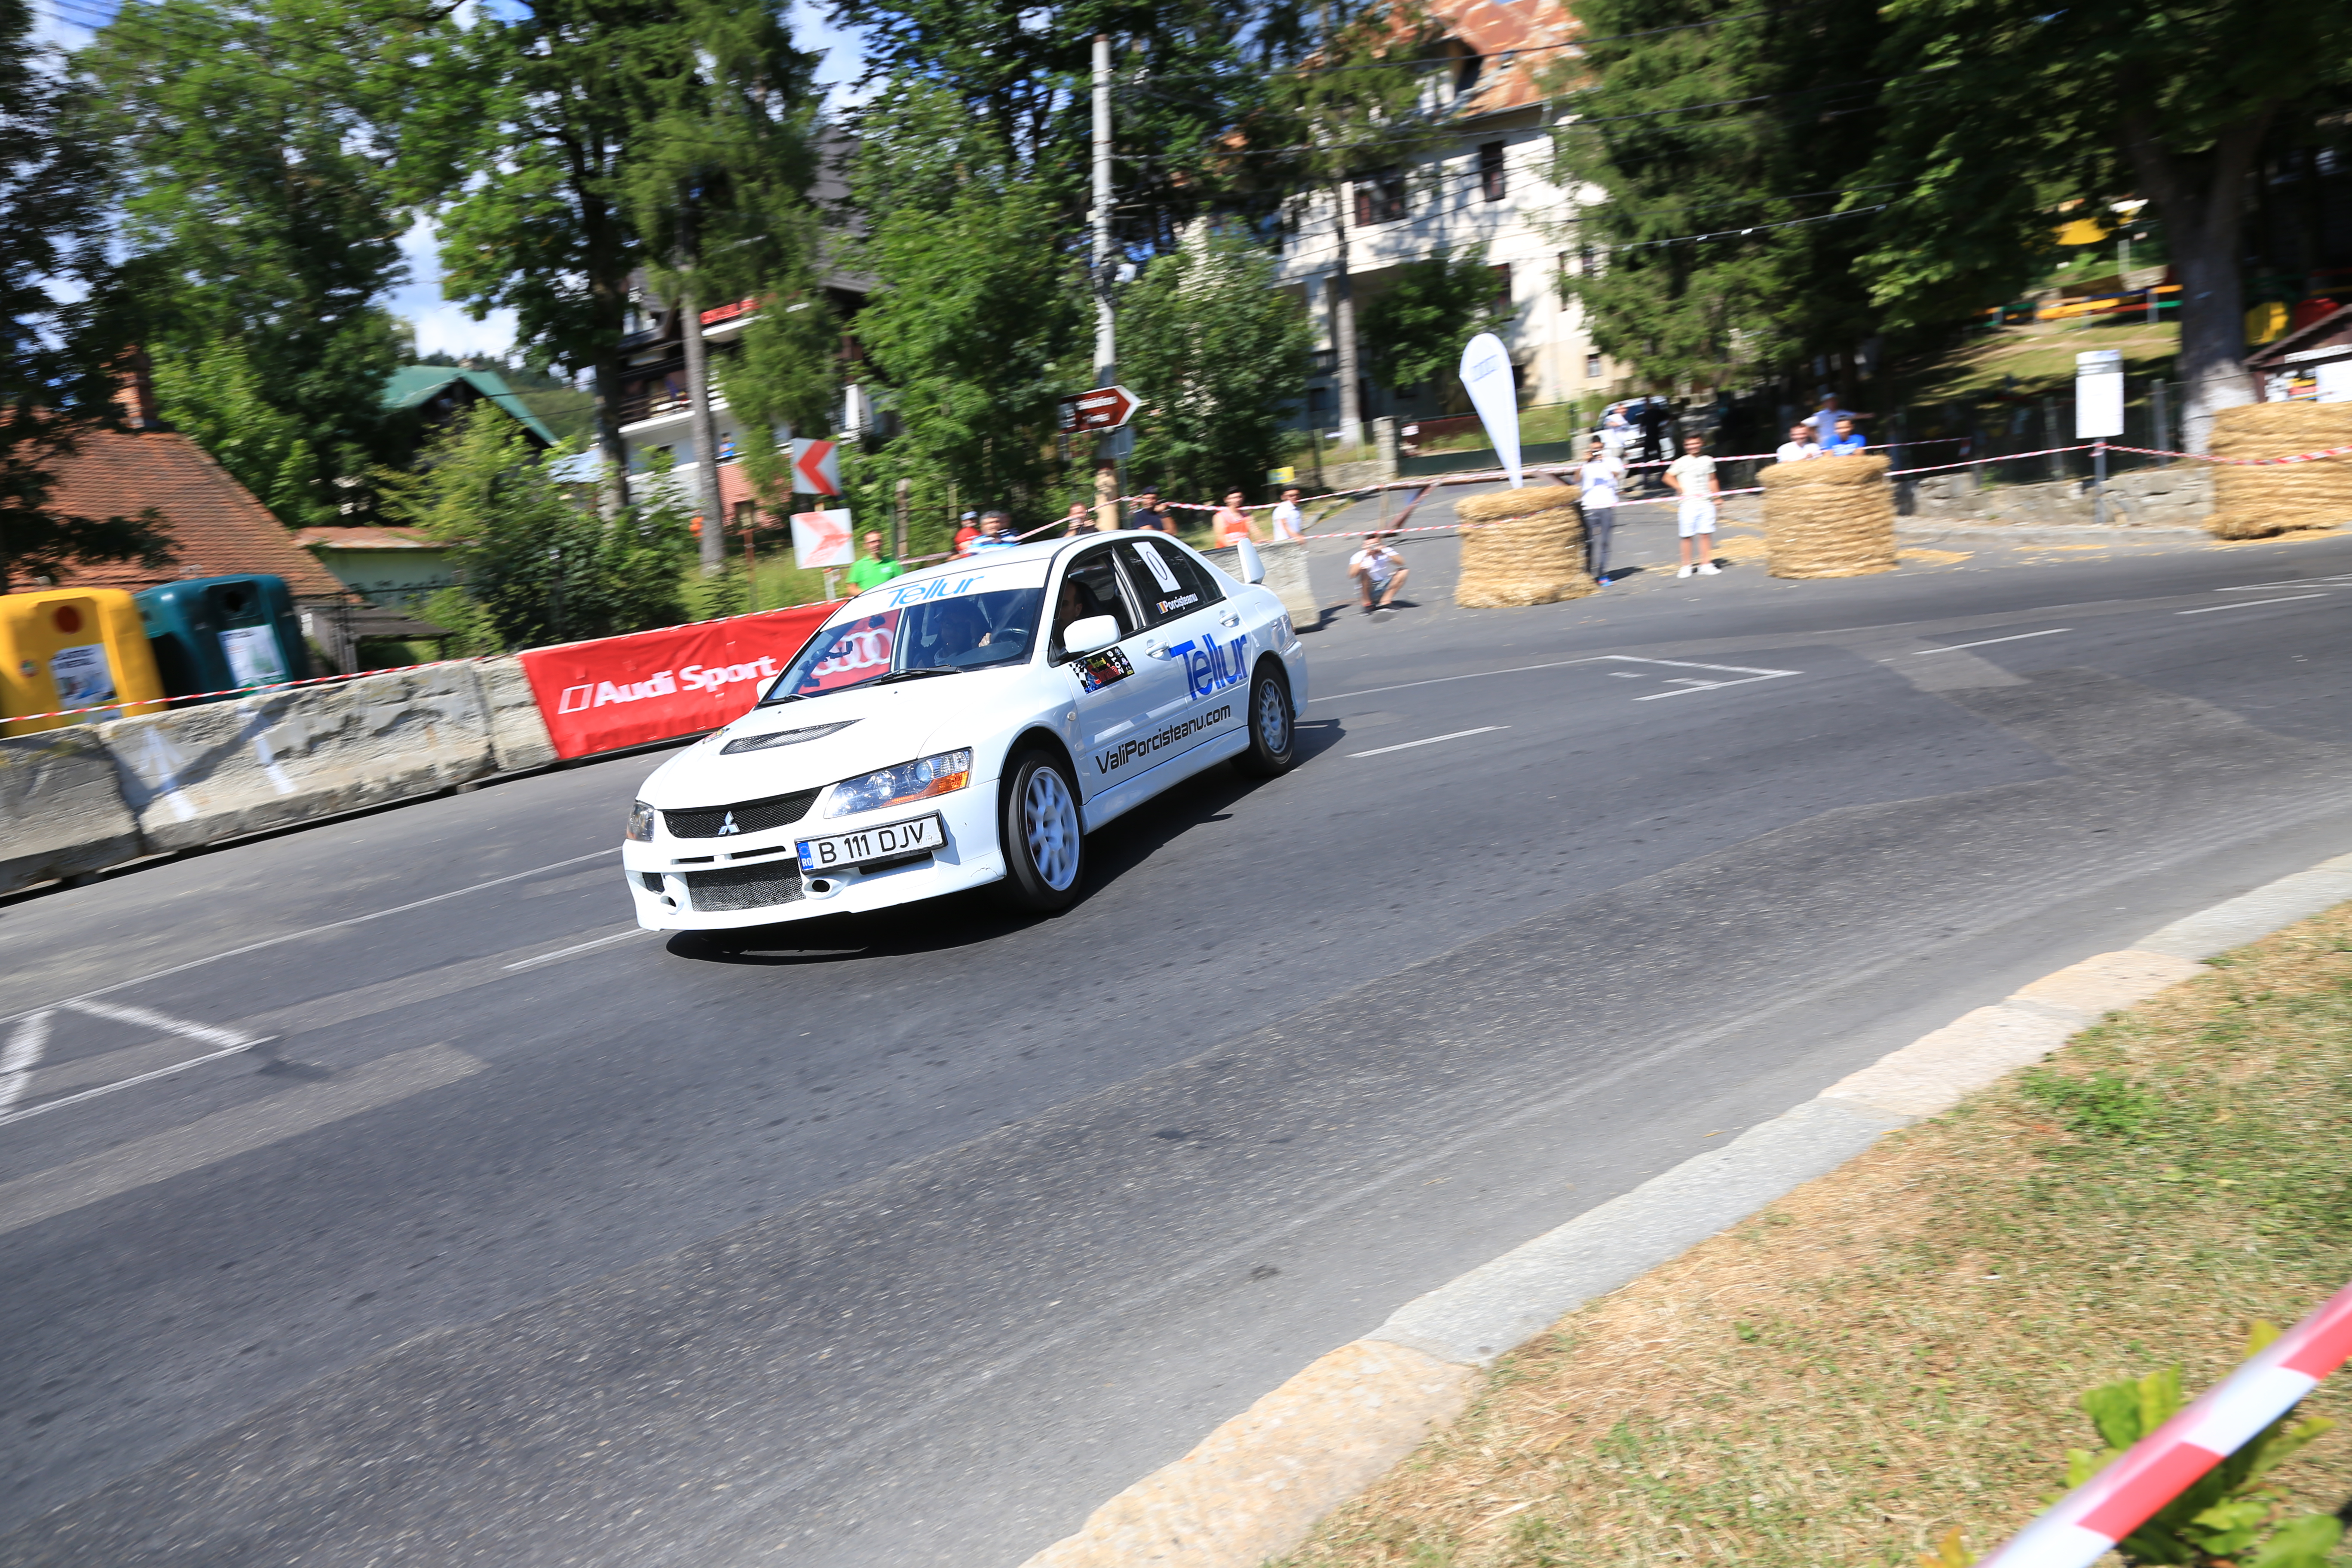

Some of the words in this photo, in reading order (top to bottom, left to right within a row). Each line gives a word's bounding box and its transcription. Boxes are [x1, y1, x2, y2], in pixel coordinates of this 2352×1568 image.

[887, 576, 985, 608] Tellur
[592, 670, 677, 708] Audi
[679, 655, 779, 693] Sport
[1106, 650, 1124, 674] 2016
[1168, 633, 1247, 701] Tellur
[1095, 704, 1231, 774] ValiPorcisteanu.com
[801, 858, 812, 867] RO
[818, 842, 836, 864] B
[844, 834, 870, 859] 111
[878, 823, 924, 852] DJV
